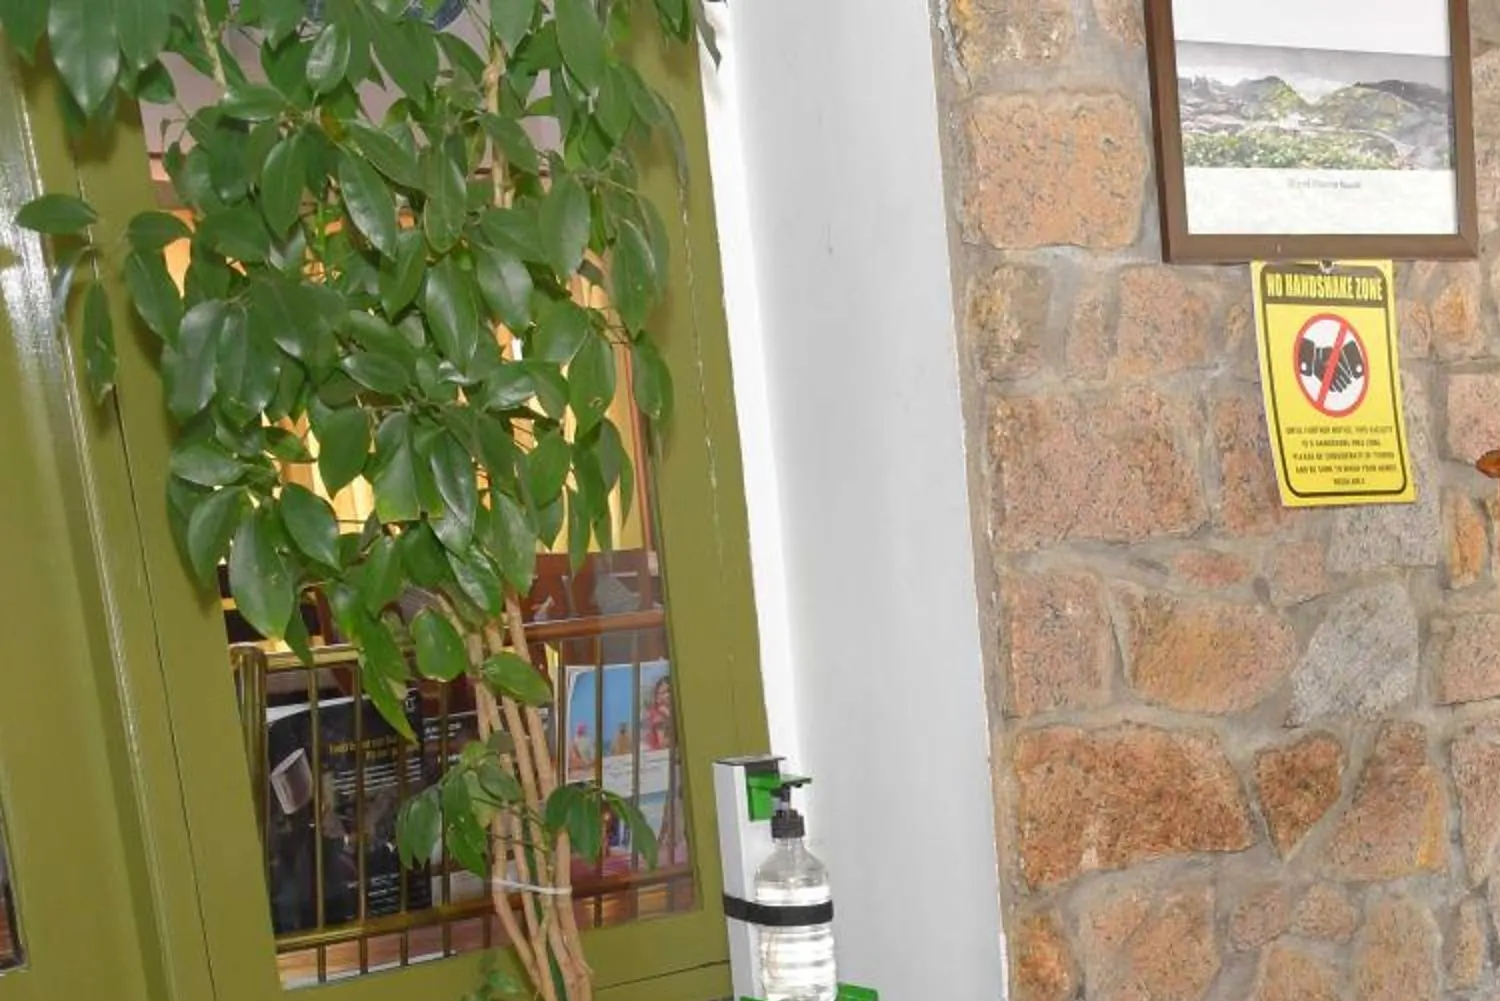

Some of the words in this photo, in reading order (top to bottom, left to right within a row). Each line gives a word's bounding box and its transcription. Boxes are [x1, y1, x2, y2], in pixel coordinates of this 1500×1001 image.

[1265, 273, 1283, 297] NO
[1285, 273, 1355, 299] HANDSHAKE
[1355, 276, 1383, 300] ZONE
